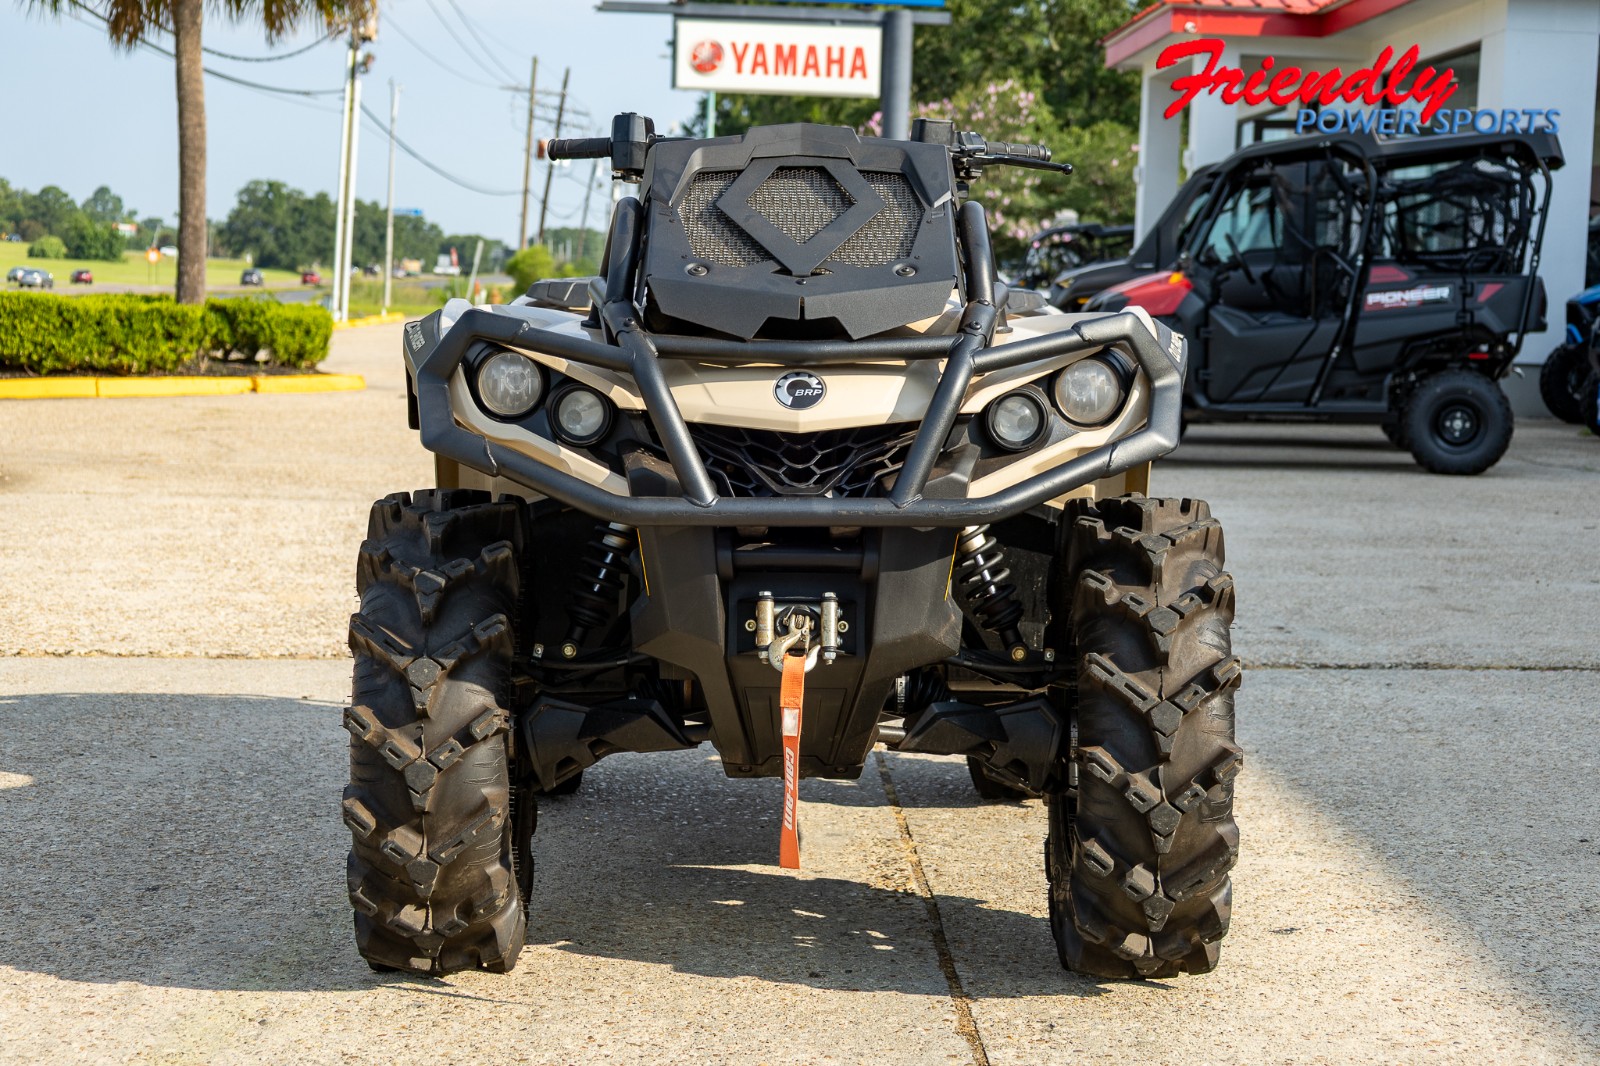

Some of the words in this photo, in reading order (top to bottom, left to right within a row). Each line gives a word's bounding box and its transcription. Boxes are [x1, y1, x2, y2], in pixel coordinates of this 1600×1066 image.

[731, 41, 868, 80] YAMAHA
[1366, 286, 1451, 306] PIONEER
[794, 388, 823, 397] BRP
